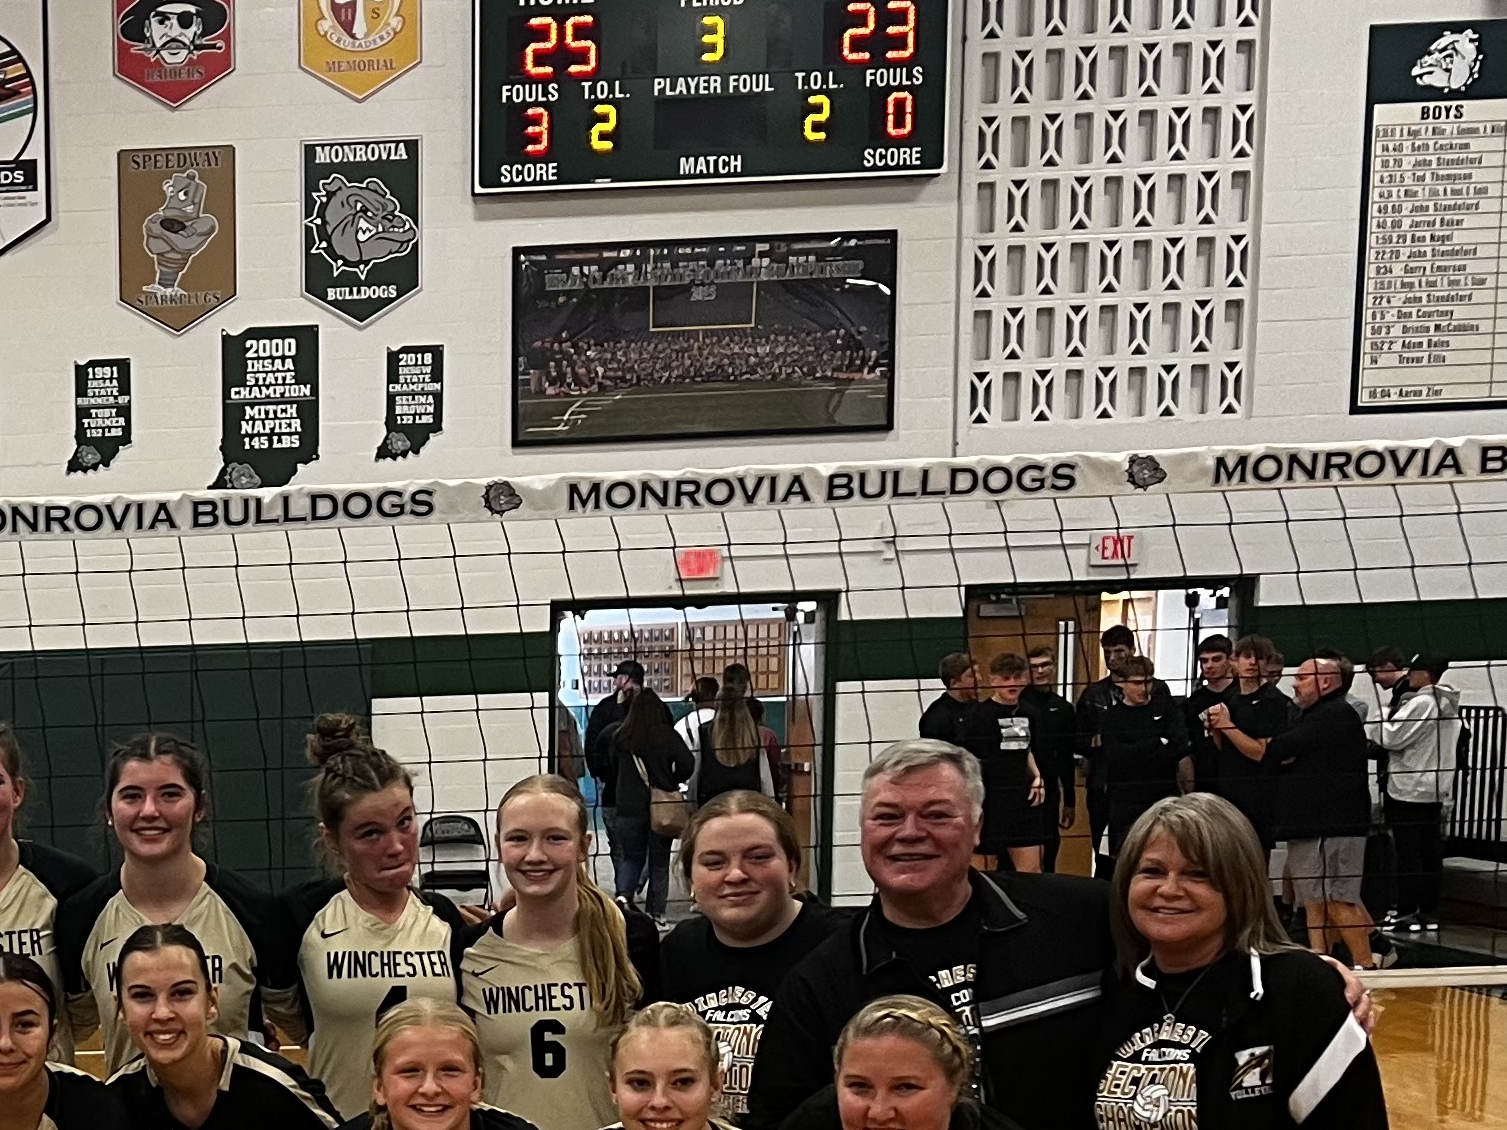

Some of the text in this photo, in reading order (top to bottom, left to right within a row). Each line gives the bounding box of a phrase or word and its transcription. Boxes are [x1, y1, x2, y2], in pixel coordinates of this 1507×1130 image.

[329, 30, 392, 49] CRUSADERS
[700, 15, 726, 63] 3
[842, 1, 917, 62] 23
[525, 14, 598, 77] 25
[146, 66, 205, 81] RAIDERS
[325, 58, 396, 73] MEMORIAL
[653, 73, 775, 97] PLAYER FOUL
[795, 71, 844, 91] T.O.L.
[865, 67, 923, 88] FOULS
[501, 83, 559, 104] FOULS
[581, 81, 631, 100] T.O.L.
[803, 94, 830, 142] 2
[887, 92, 913, 138] 0
[1420, 104, 1464, 121] BOYS
[524, 107, 549, 155] 3
[590, 104, 617, 151] 2
[130, 151, 222, 170] SPEEDWAY
[315, 143, 407, 163] MONROVIA
[863, 148, 922, 168] SCORE
[500, 163, 558, 183] SCORE
[679, 155, 742, 175] MATCH
[136, 291, 221, 307] SPARKPLUGS
[327, 285, 397, 300] BULLDOGS
[245, 338, 296, 358] 2000
[246, 358, 294, 372] IHSAA
[398, 352, 433, 366] 2018
[87, 366, 118, 379] 1991
[246, 371, 295, 386] STATE
[399, 374, 432, 383] STATE
[87, 387, 119, 396] STATE
[230, 384, 311, 400] CHAMPION
[389, 382, 441, 392] CHAMPION
[395, 395, 434, 405] SELINA
[395, 404, 435, 414] BROWN
[245, 404, 297, 420] MITCH
[241, 418, 302, 435] NAPIER
[244, 435, 300, 449] 145 LBS
[1213, 447, 1465, 485] MONROVIA
[568, 462, 1077, 512] MONROVIA BULLDOGS
[191, 489, 435, 528] BULLDOGS
[1101, 535, 1134, 560] EXIT
[327, 950, 450, 980] WINCHESTER
[482, 982, 587, 1016] WINCHEST
[530, 1018, 567, 1079] 6
[1141, 1048, 1192, 1062] FALCONS
